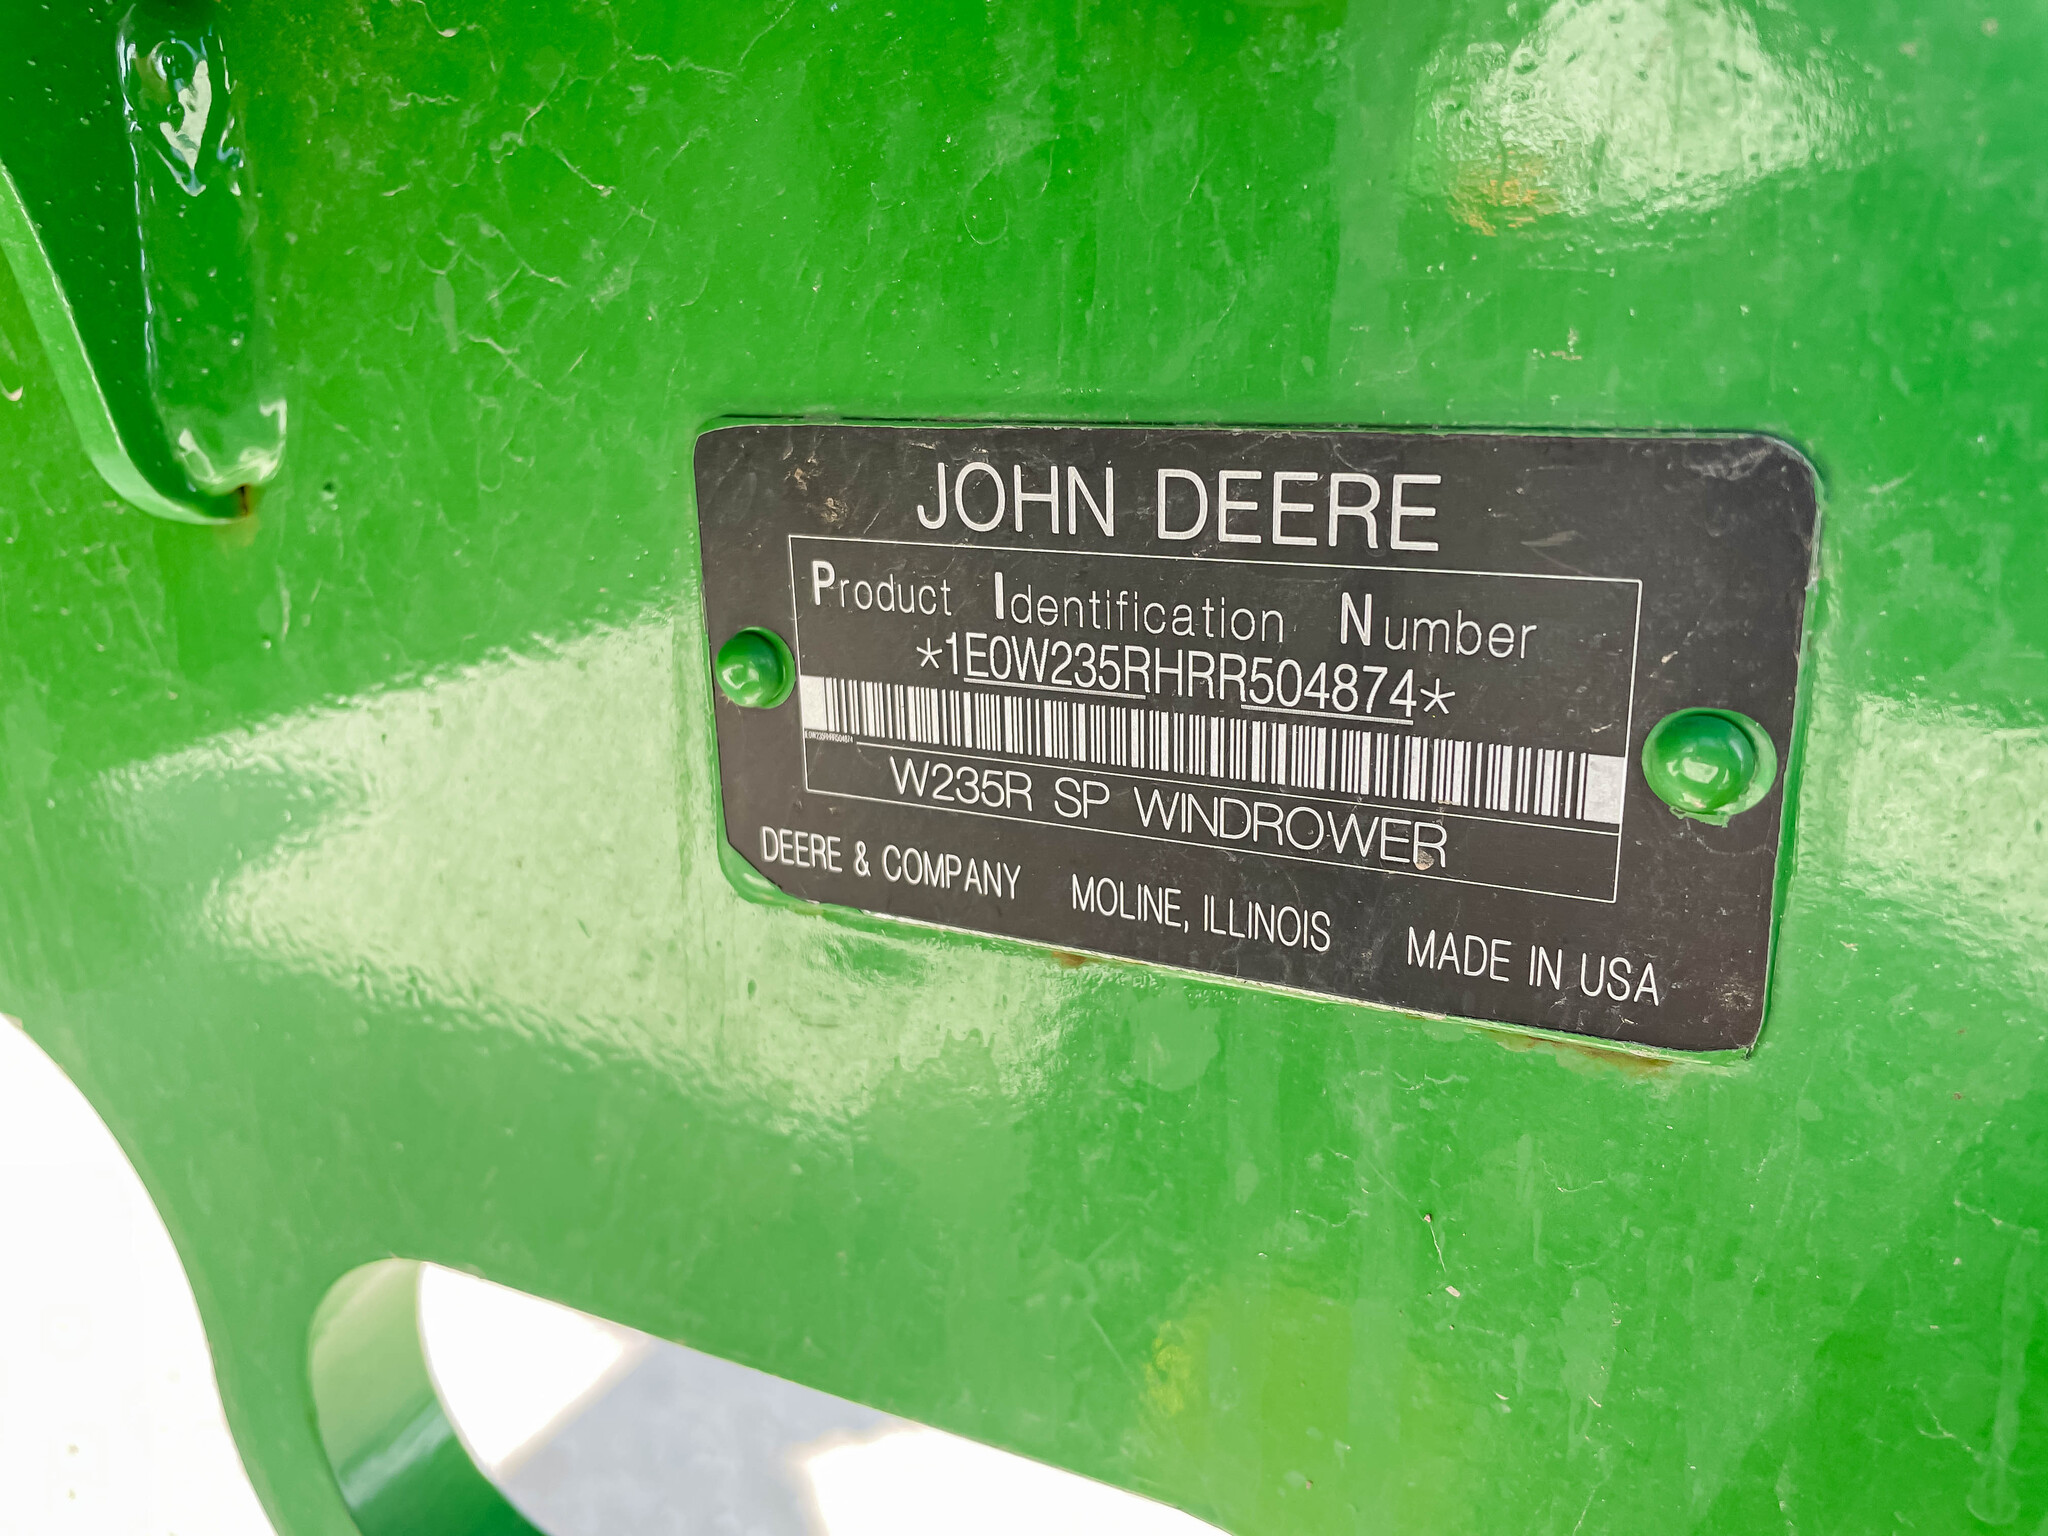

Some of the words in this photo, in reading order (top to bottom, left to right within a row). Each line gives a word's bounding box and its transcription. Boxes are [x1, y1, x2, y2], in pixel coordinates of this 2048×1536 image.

[917, 462, 1114, 536] JOHN
[1158, 469, 1441, 551] DEERE
[812, 560, 951, 616] Product
[993, 572, 1284, 643] Identification
[1341, 592, 1537, 658] Number
[889, 756, 1033, 813] W235R
[1055, 777, 1109, 819] SP
[1134, 786, 1448, 869] WINDROWER
[760, 826, 842, 872] DEERE
[854, 841, 871, 876] &
[882, 845, 1021, 899] COMPANY
[1072, 874, 1188, 933] MOLINE,
[1204, 895, 1330, 952] ILLINOIS
[1408, 927, 1511, 981] MADE
[1529, 945, 1562, 990] IN
[1581, 956, 1659, 1005] USA
